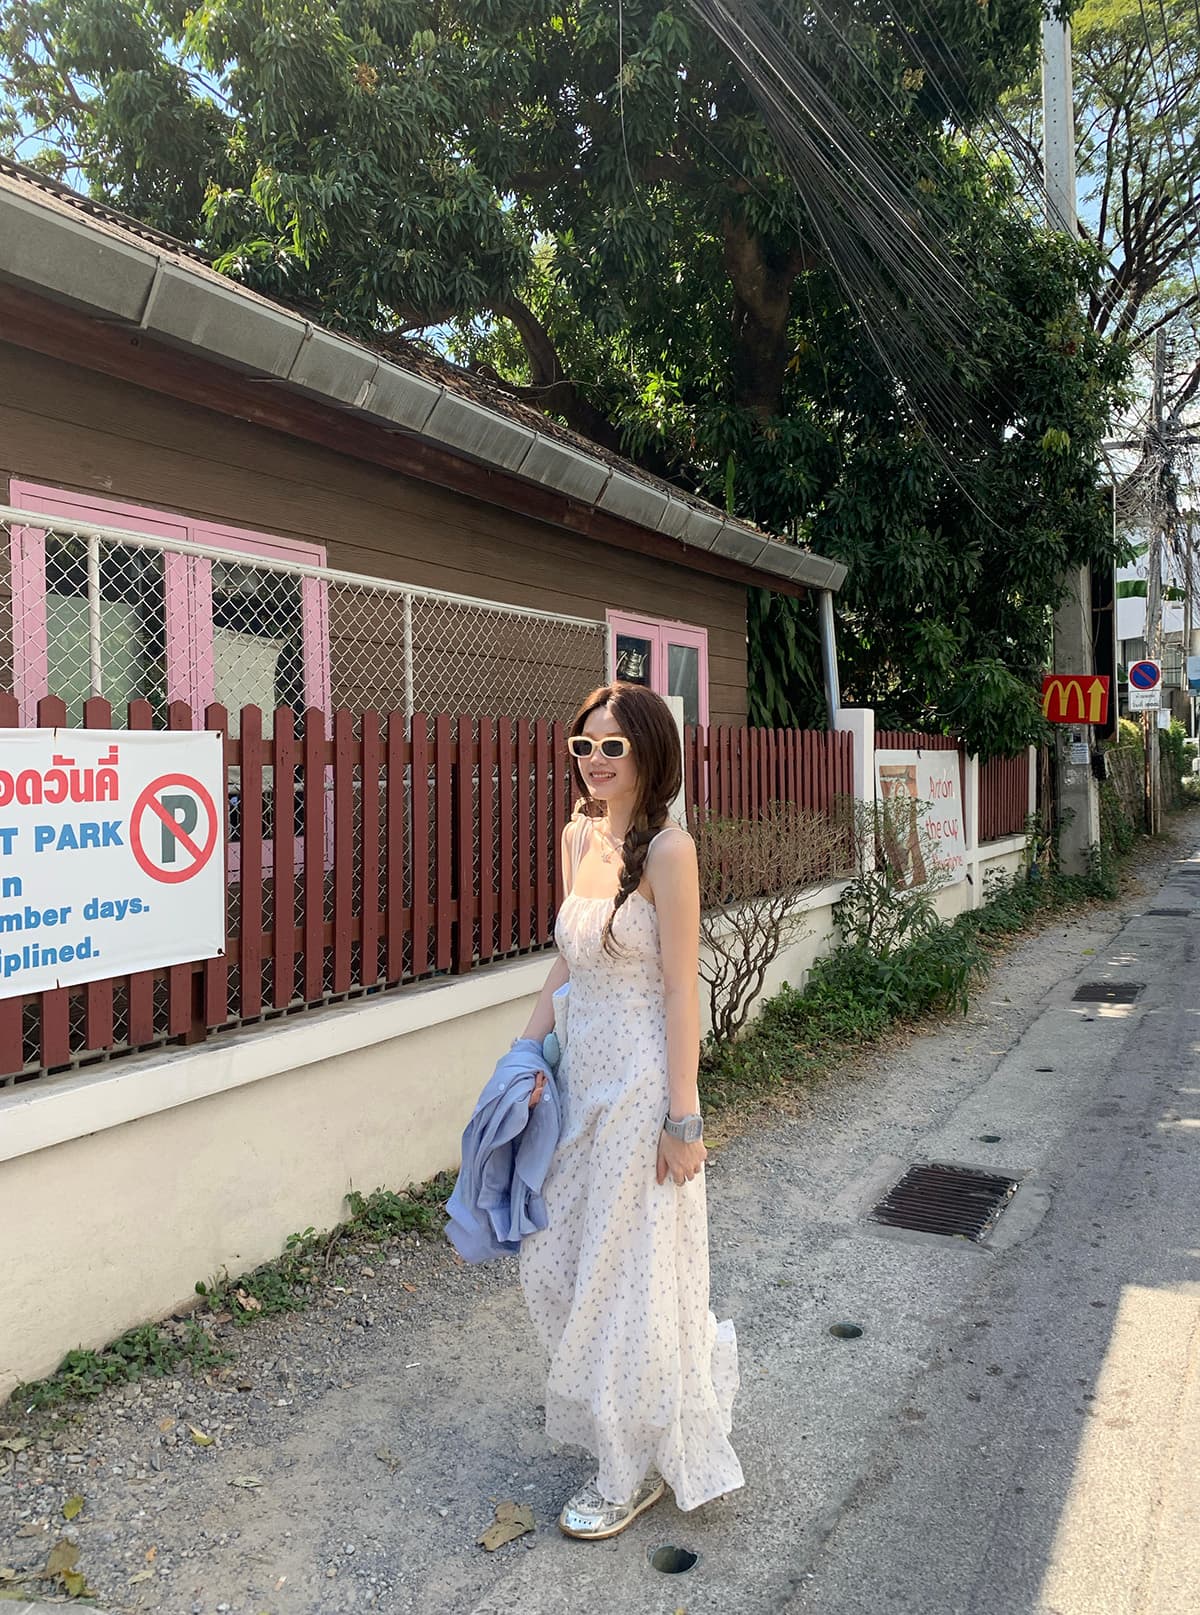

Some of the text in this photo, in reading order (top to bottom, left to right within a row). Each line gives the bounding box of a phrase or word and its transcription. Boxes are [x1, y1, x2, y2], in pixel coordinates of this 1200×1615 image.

[34, 820, 124, 853] PARK
[925, 816, 941, 840] the
[0, 897, 150, 933] mber days.
[0, 936, 100, 977] plined.
